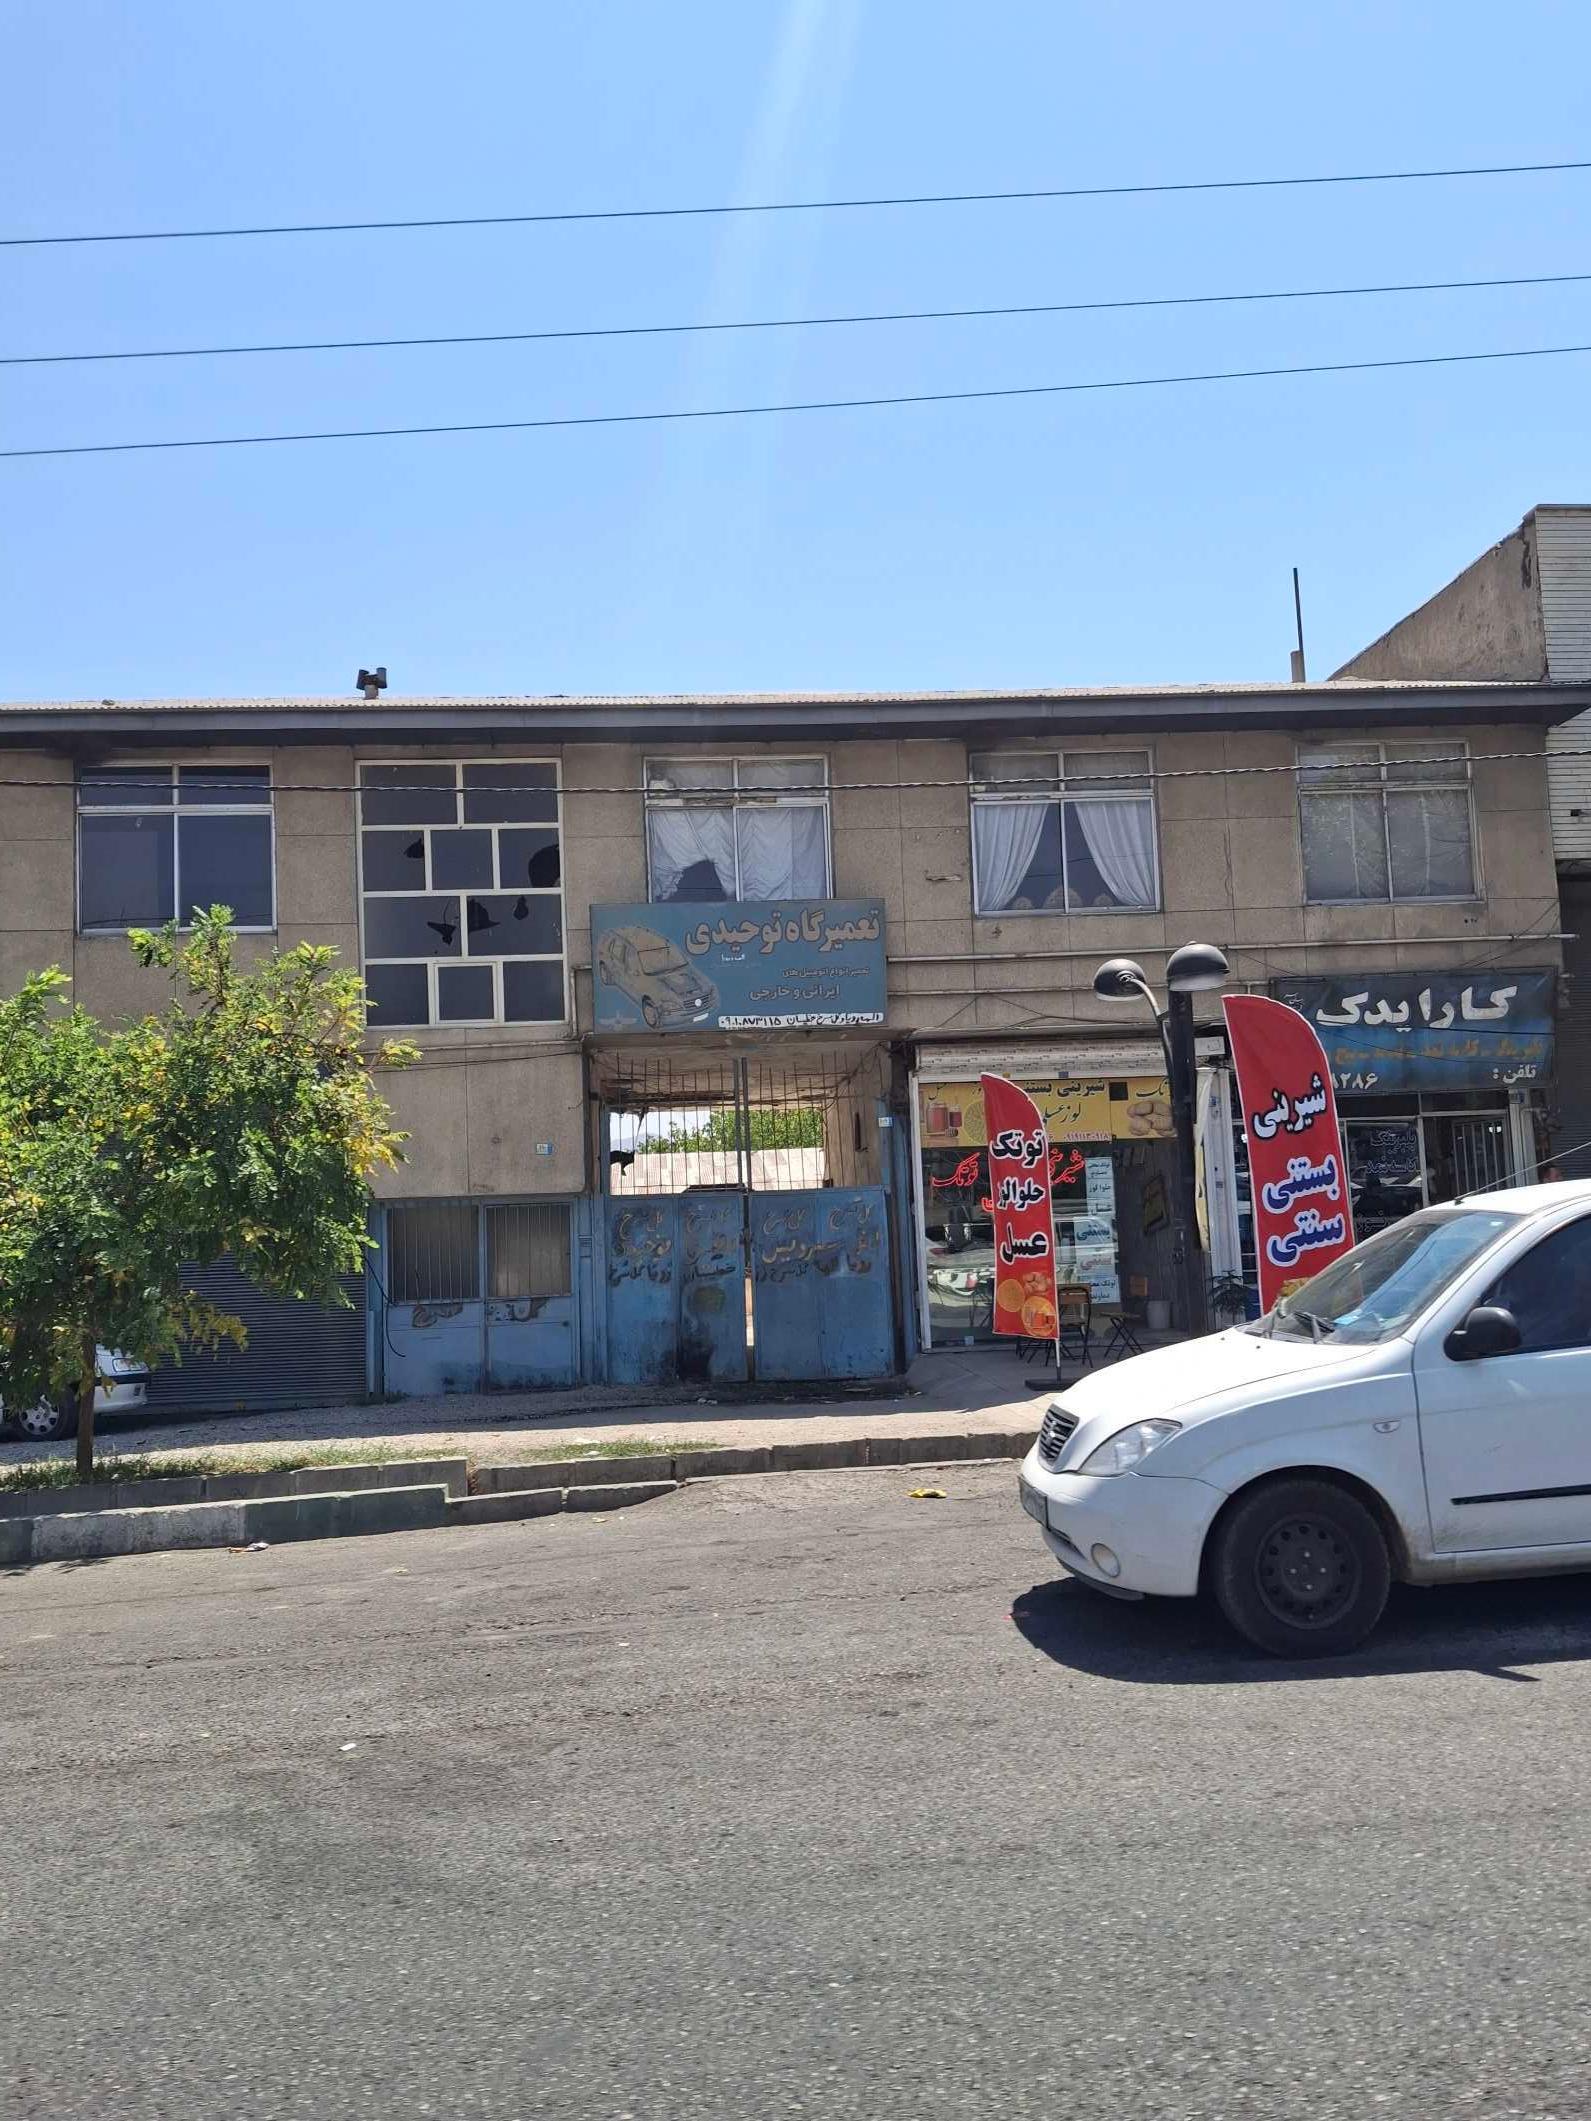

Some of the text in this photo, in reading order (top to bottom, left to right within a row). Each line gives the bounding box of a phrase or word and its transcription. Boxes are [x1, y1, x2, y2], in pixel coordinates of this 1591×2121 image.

[684, 908, 879, 955] تعمیرگاه توحیدی
[749, 983, 841, 1001] ایرانی و خارجی
[1252, 1072, 1327, 1139] شیرینی
[990, 1130, 1045, 1168] توتک
[1011, 1176, 1046, 1210] حلوا
[1262, 1154, 1340, 1213] بستنی
[1000, 1222, 1049, 1265] عسل
[1266, 1208, 1346, 1267] سنتی
